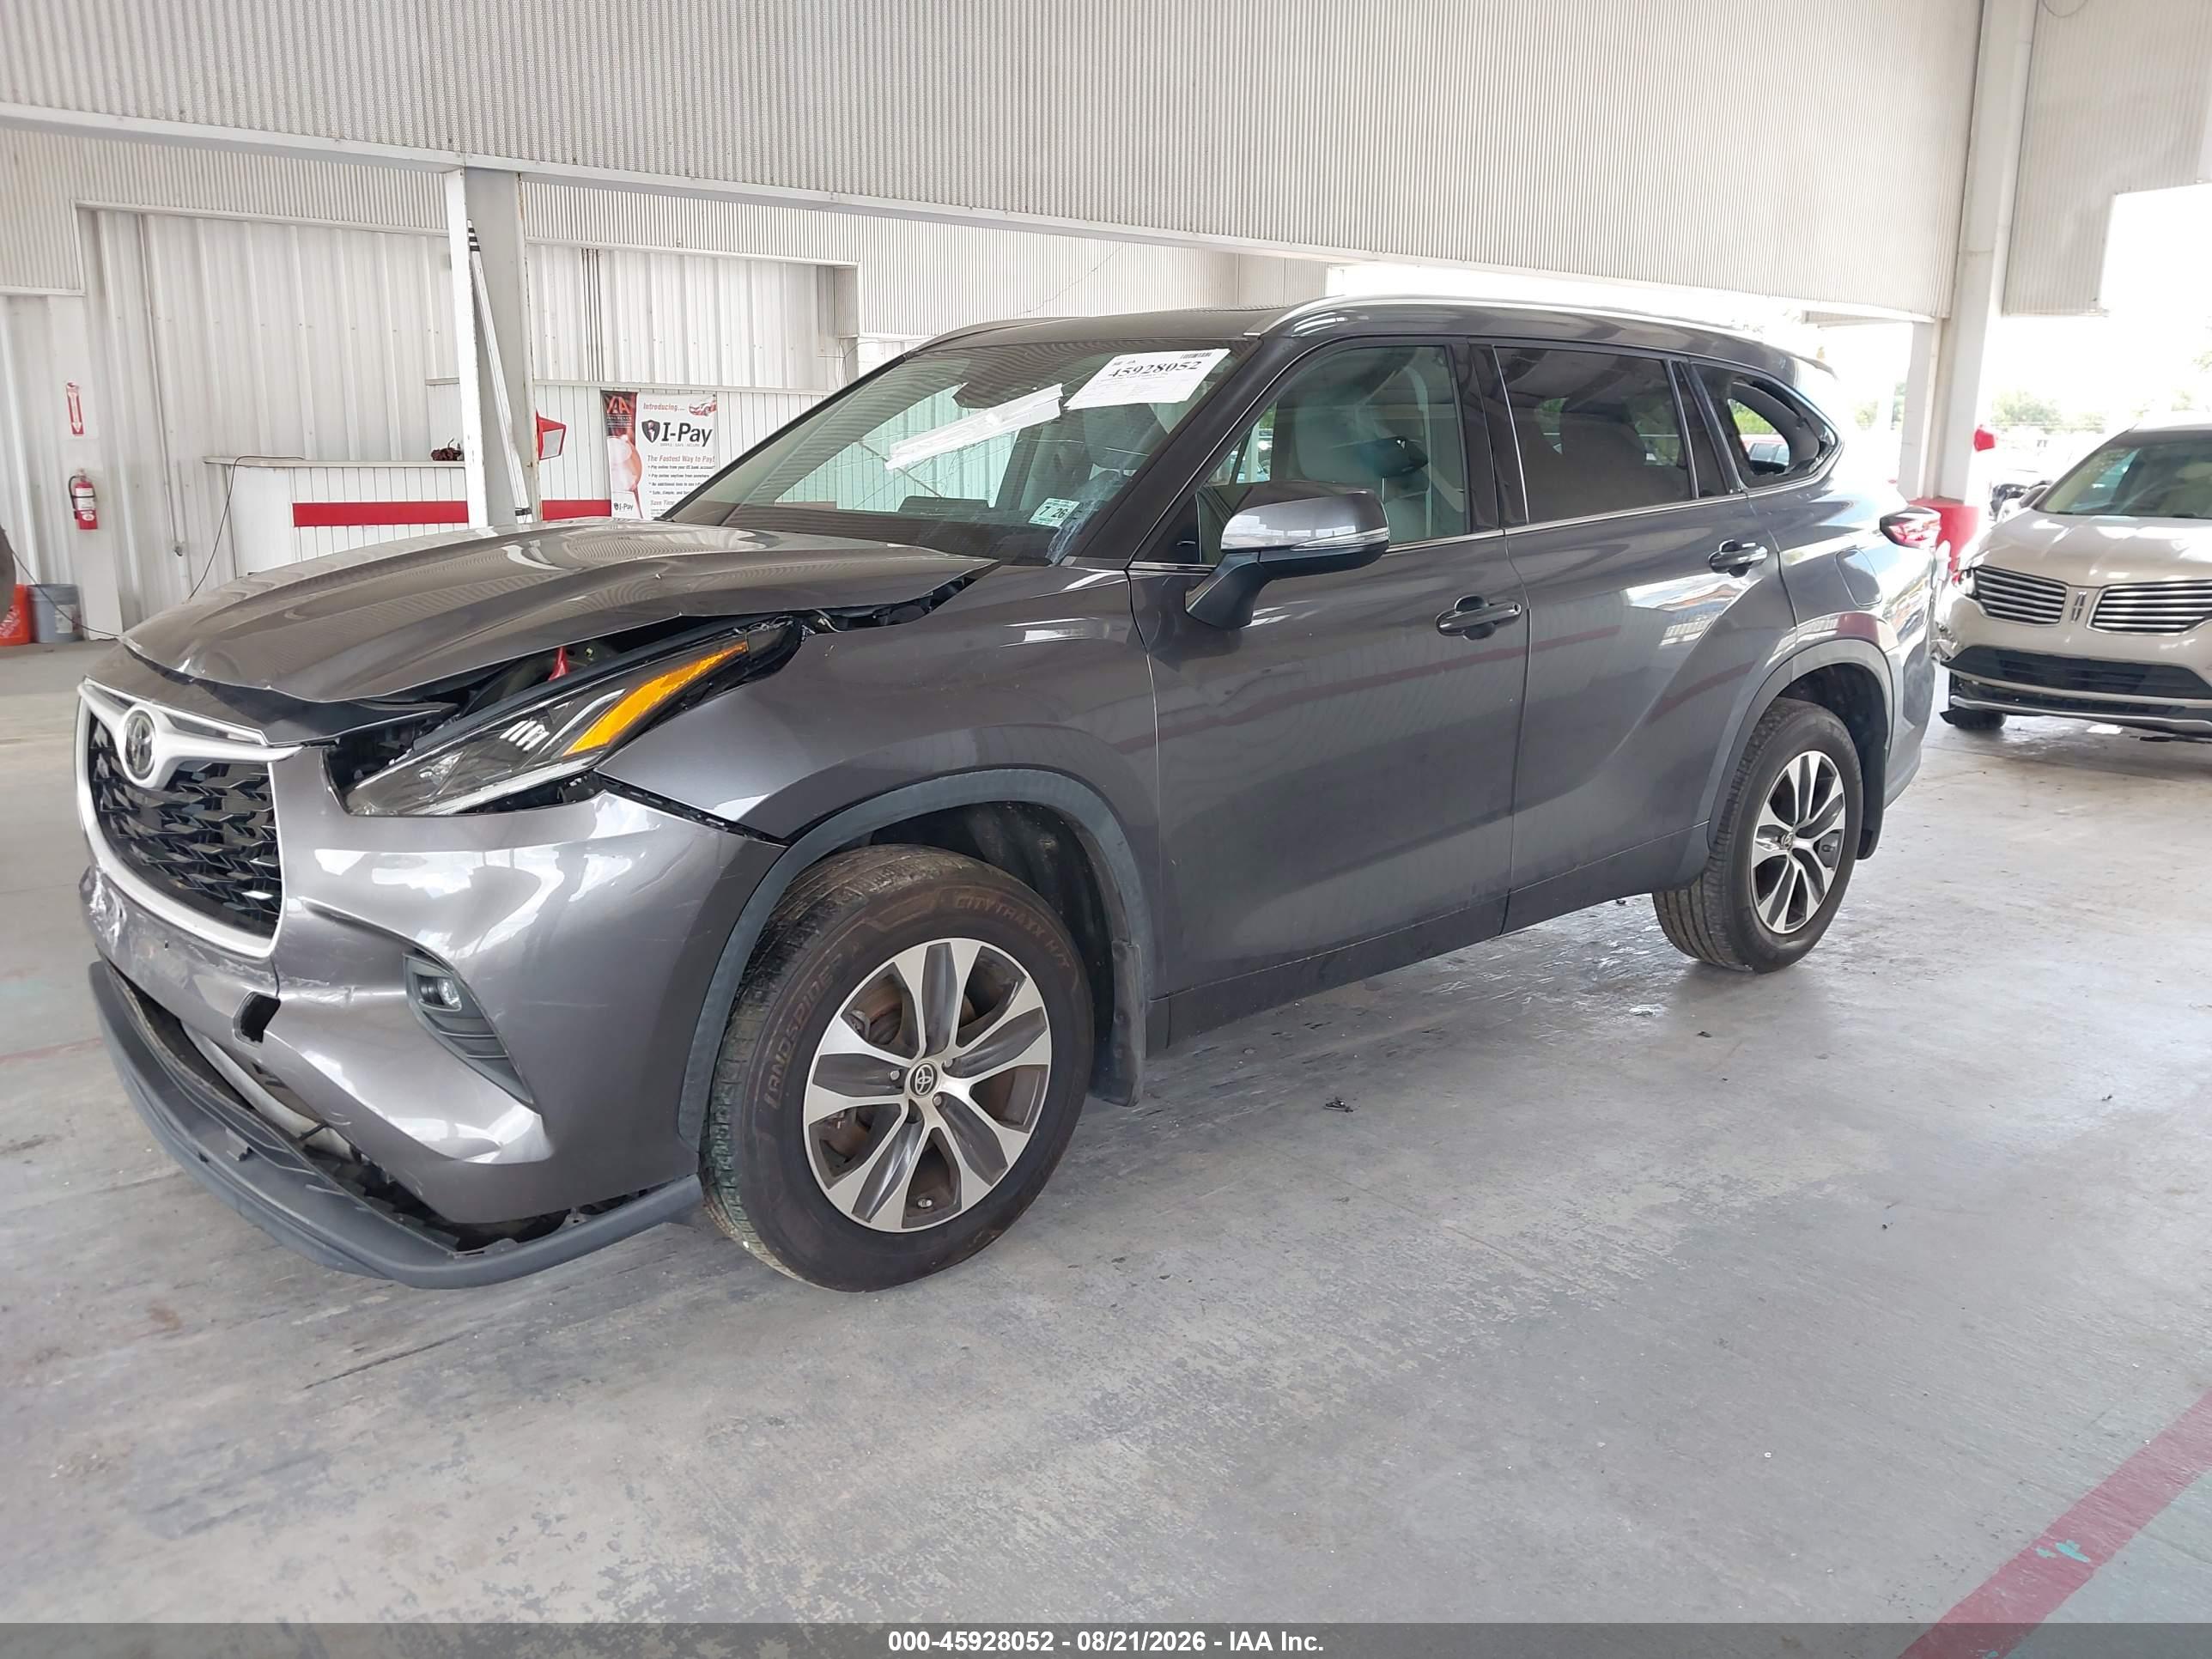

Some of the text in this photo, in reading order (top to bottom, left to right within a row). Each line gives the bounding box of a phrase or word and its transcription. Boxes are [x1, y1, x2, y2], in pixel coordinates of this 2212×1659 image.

[1108, 361, 1202, 377] 45928052
[661, 422, 714, 447] I-Pay
[682, 455, 694, 464] Way
[702, 455, 715, 464] Pay!
[619, 502, 634, 511] I-Pay
[1039, 506, 1069, 519] 7 26
